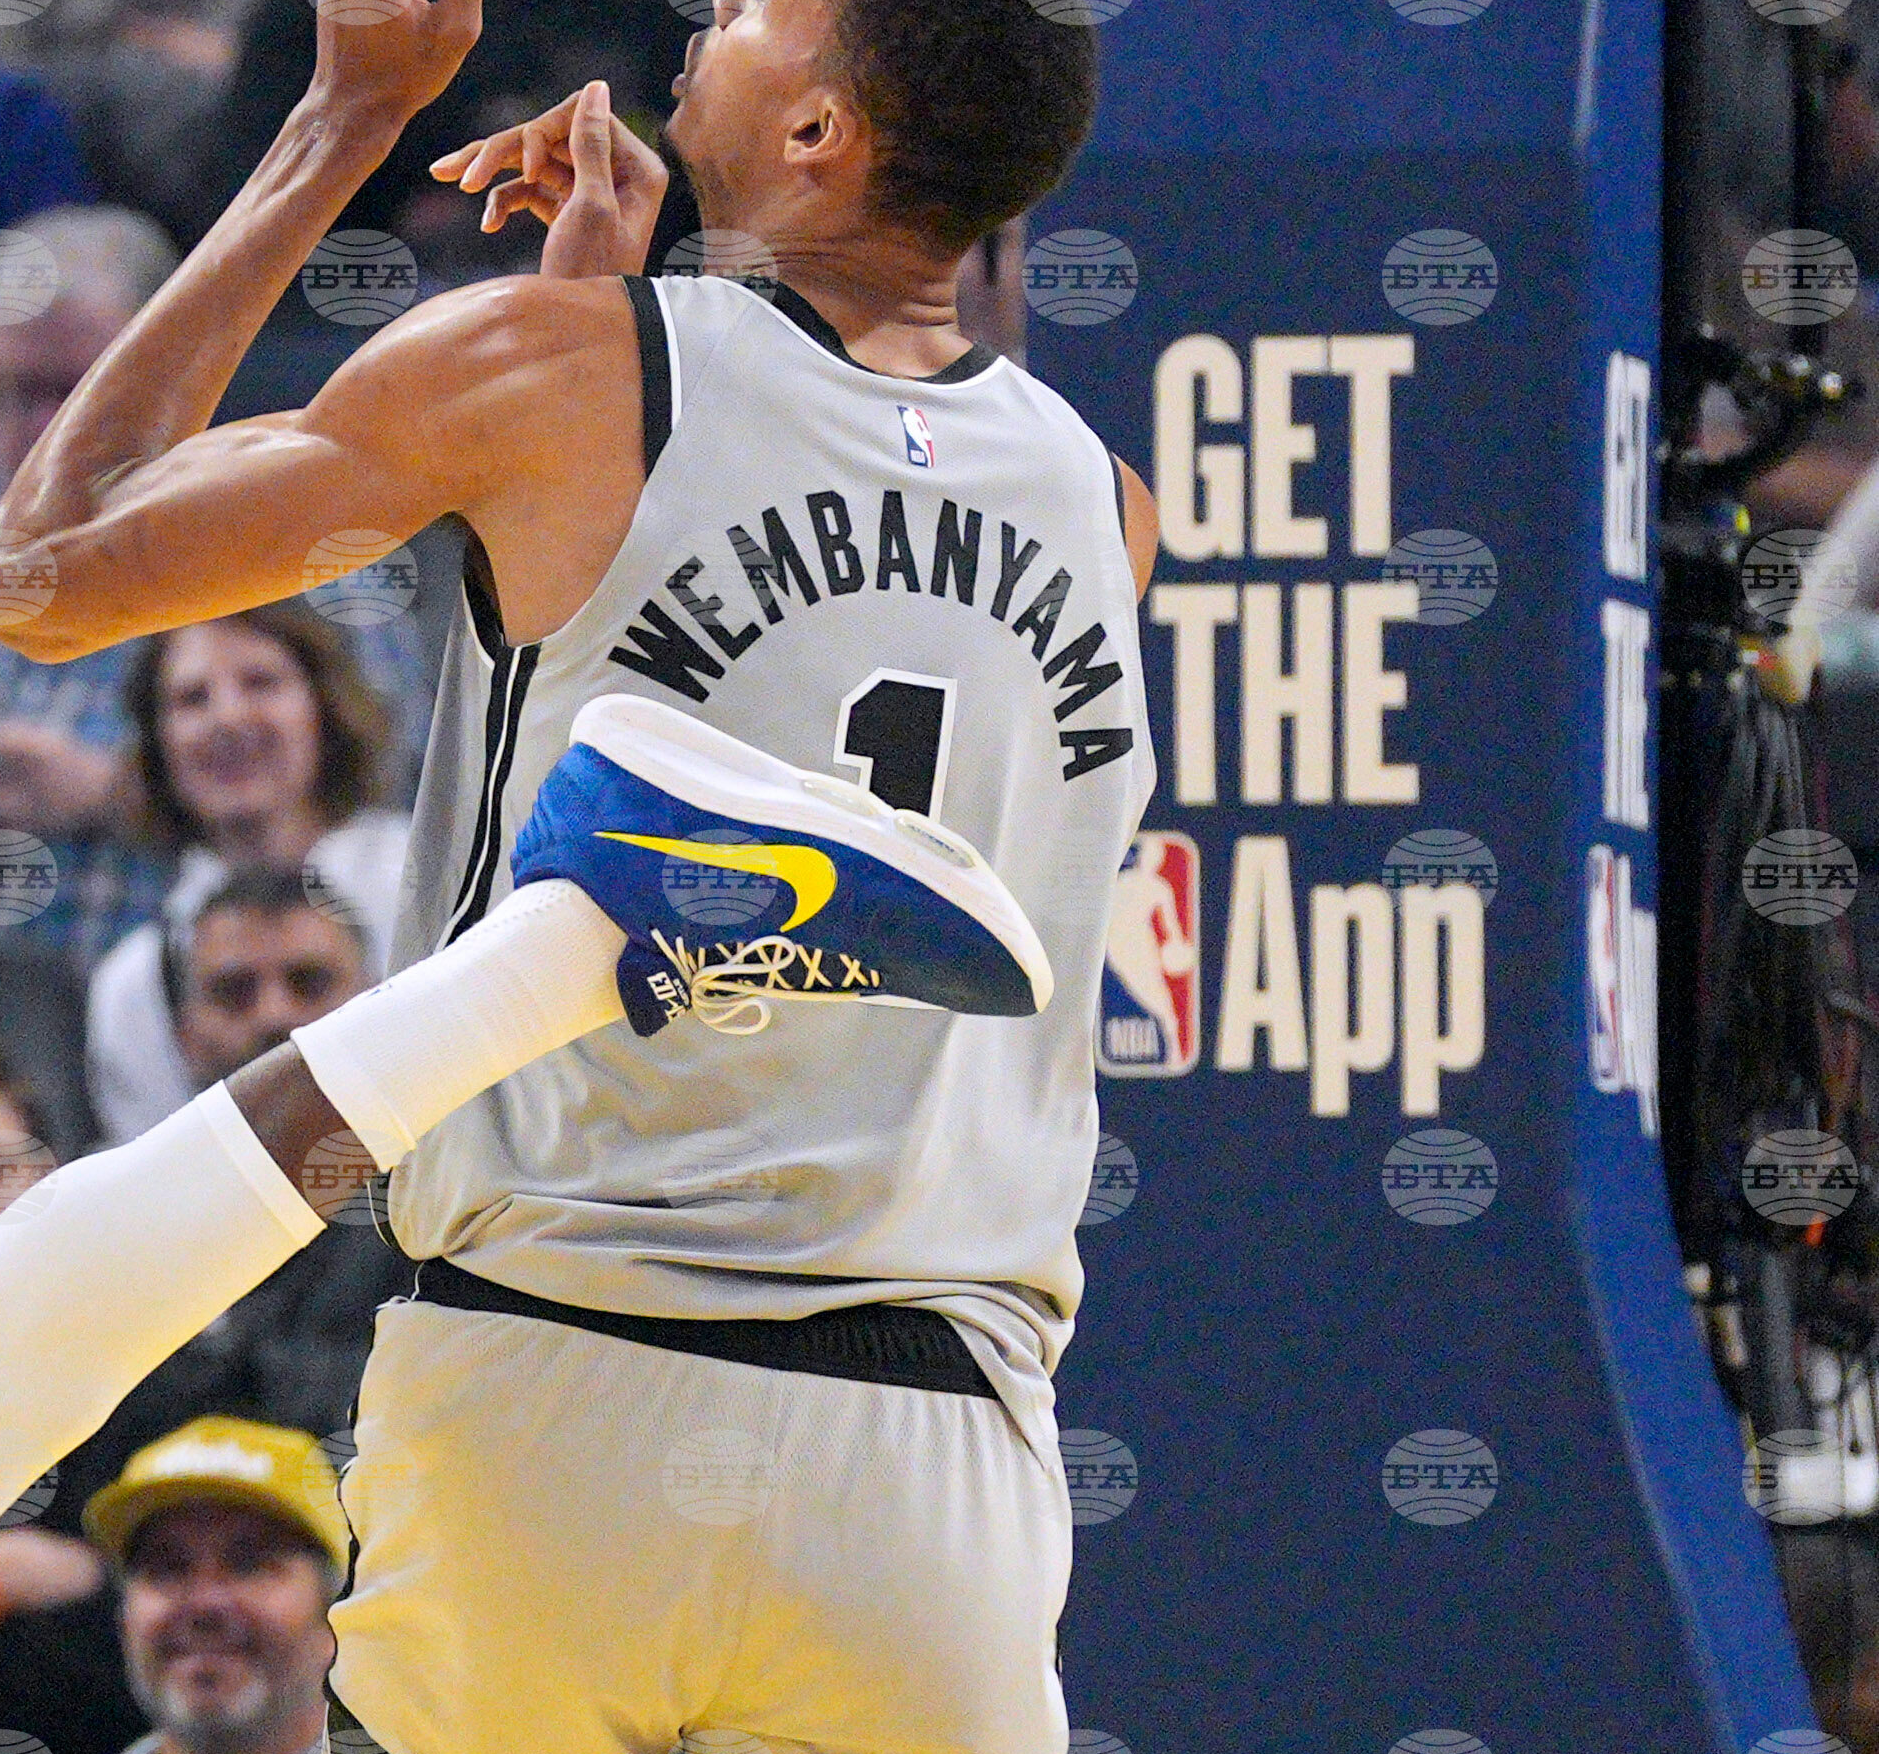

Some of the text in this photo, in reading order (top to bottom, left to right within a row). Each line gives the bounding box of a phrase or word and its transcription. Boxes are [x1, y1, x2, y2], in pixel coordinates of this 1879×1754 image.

[1152, 333, 1416, 562] GET
[607, 489, 1134, 782] WEMBANYAMA
[835, 668, 957, 819] 1
[1149, 579, 1423, 807] THE
[1215, 835, 1486, 1118] App
